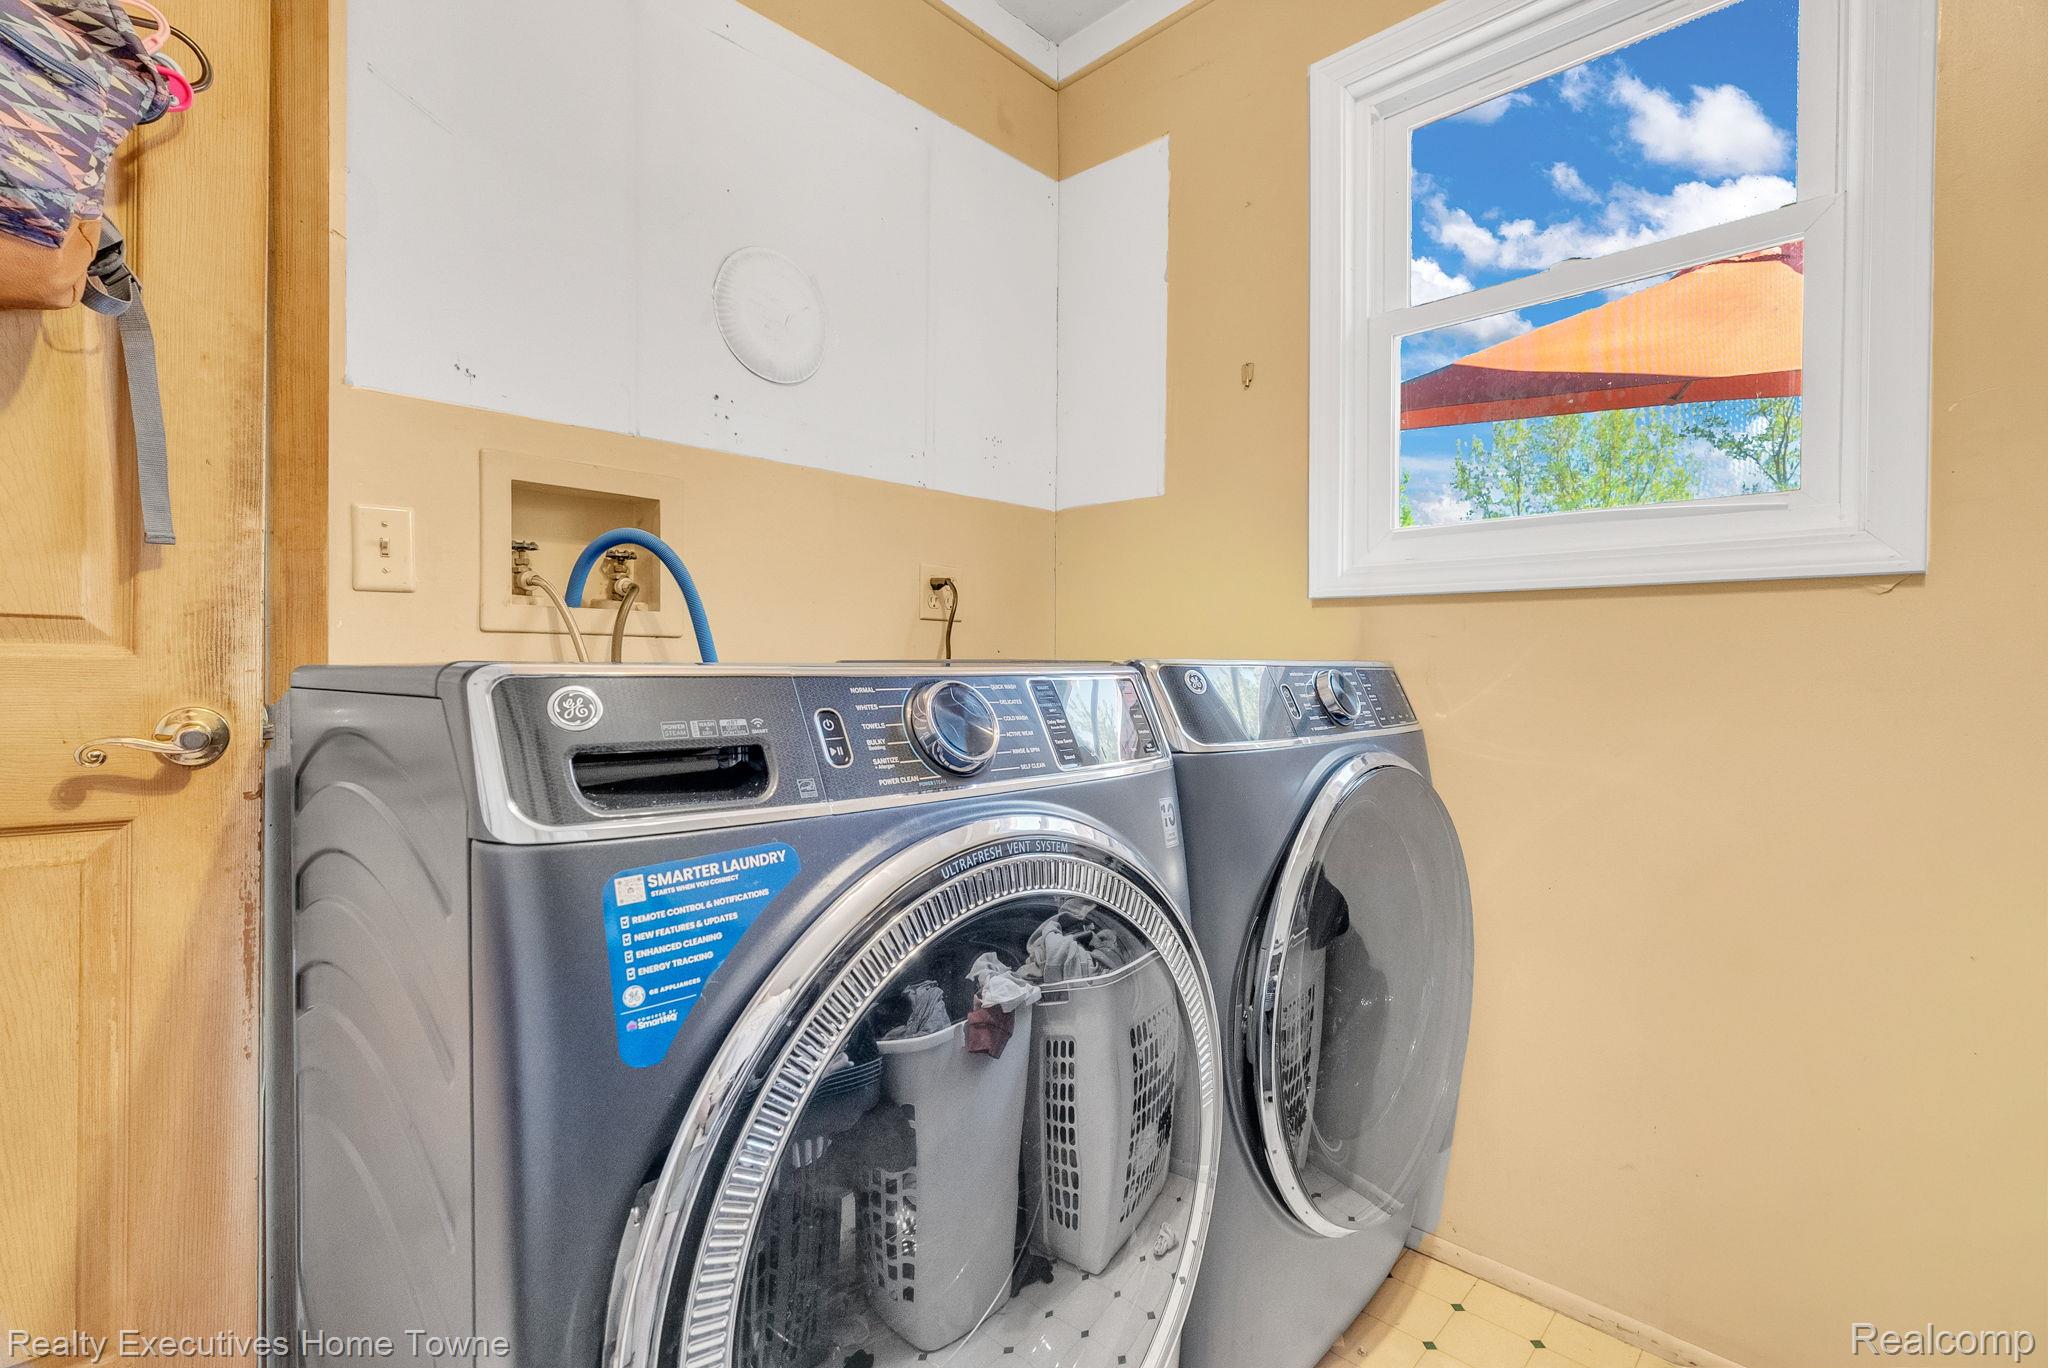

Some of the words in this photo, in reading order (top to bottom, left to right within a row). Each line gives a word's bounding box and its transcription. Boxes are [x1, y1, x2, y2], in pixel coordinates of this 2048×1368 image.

[873, 757, 899, 765] SANITIZE
[879, 777, 900, 786] POWER
[900, 775, 920, 784] CLEAN
[647, 862, 720, 888] SMARTER
[722, 849, 786, 874] LAUNDRY
[941, 844, 1003, 880] ULTRAFRESH
[1007, 840, 1031, 855] VENT
[1036, 840, 1068, 854] SYSTEM
[650, 886, 676, 897] STARTS
[676, 882, 696, 892] WHEN
[695, 879, 710, 888] YOU
[710, 874, 739, 886] CONNECT
[631, 909, 666, 925] REMOTE
[667, 903, 705, 917] CONTROL
[706, 901, 713, 909] &
[714, 888, 770, 907] NOTIFICATIONS
[634, 930, 655, 942] NEW
[655, 920, 696, 937] FEATURES
[696, 919, 704, 928] &
[704, 912, 738, 926] UPDATES
[636, 941, 682, 959] ENHANCED
[683, 931, 723, 948] CLEANING
[638, 961, 672, 976] ENERGY
[672, 951, 714, 969] TRACKING
[660, 977, 702, 993] APPLIANCES
[637, 1013, 678, 1030] SmartHQ
